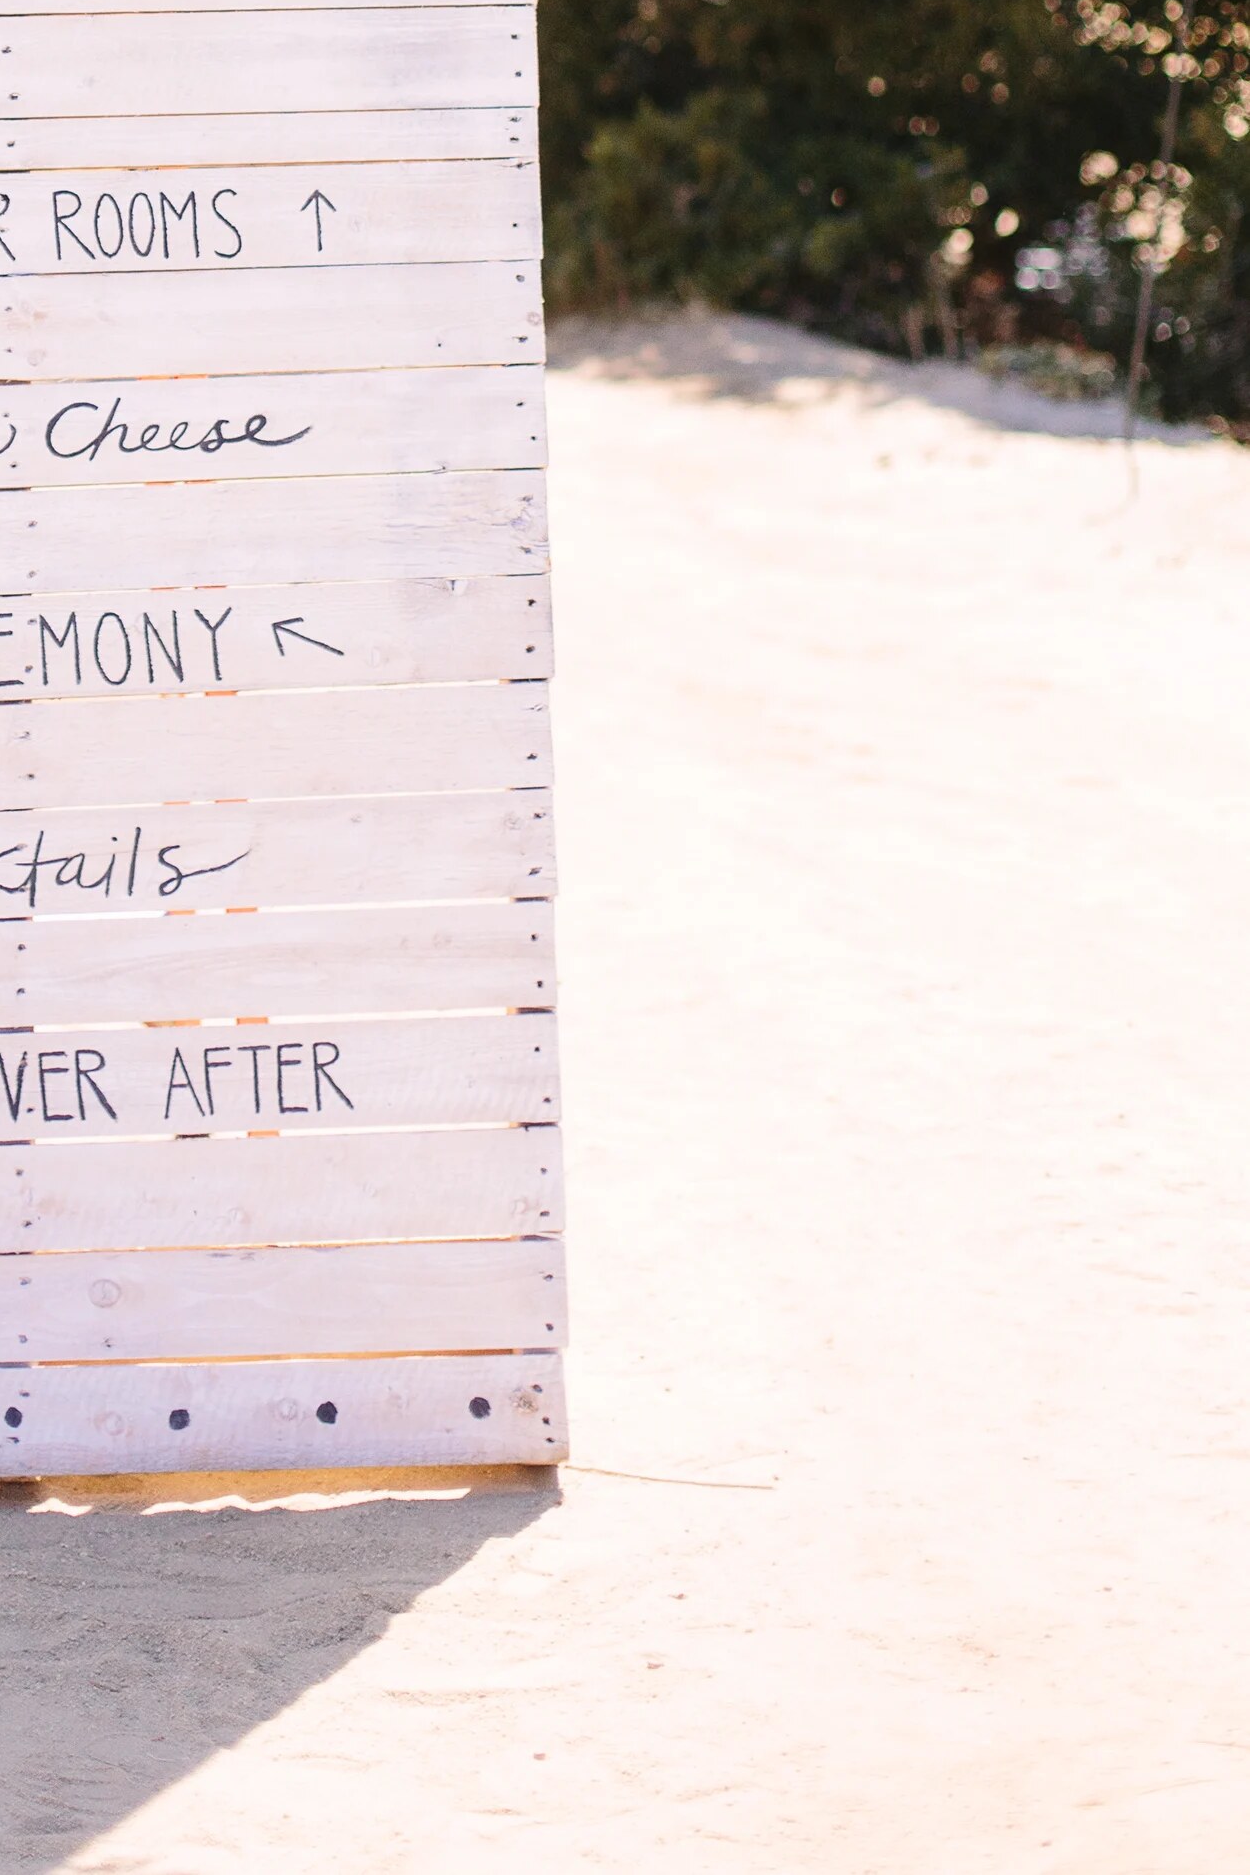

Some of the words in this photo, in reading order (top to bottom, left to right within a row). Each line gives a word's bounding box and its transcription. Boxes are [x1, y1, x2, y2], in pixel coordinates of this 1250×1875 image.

[52, 188, 243, 261] ROOMS
[45, 397, 311, 461] Cheese
[164, 1041, 354, 1120] AFTER
